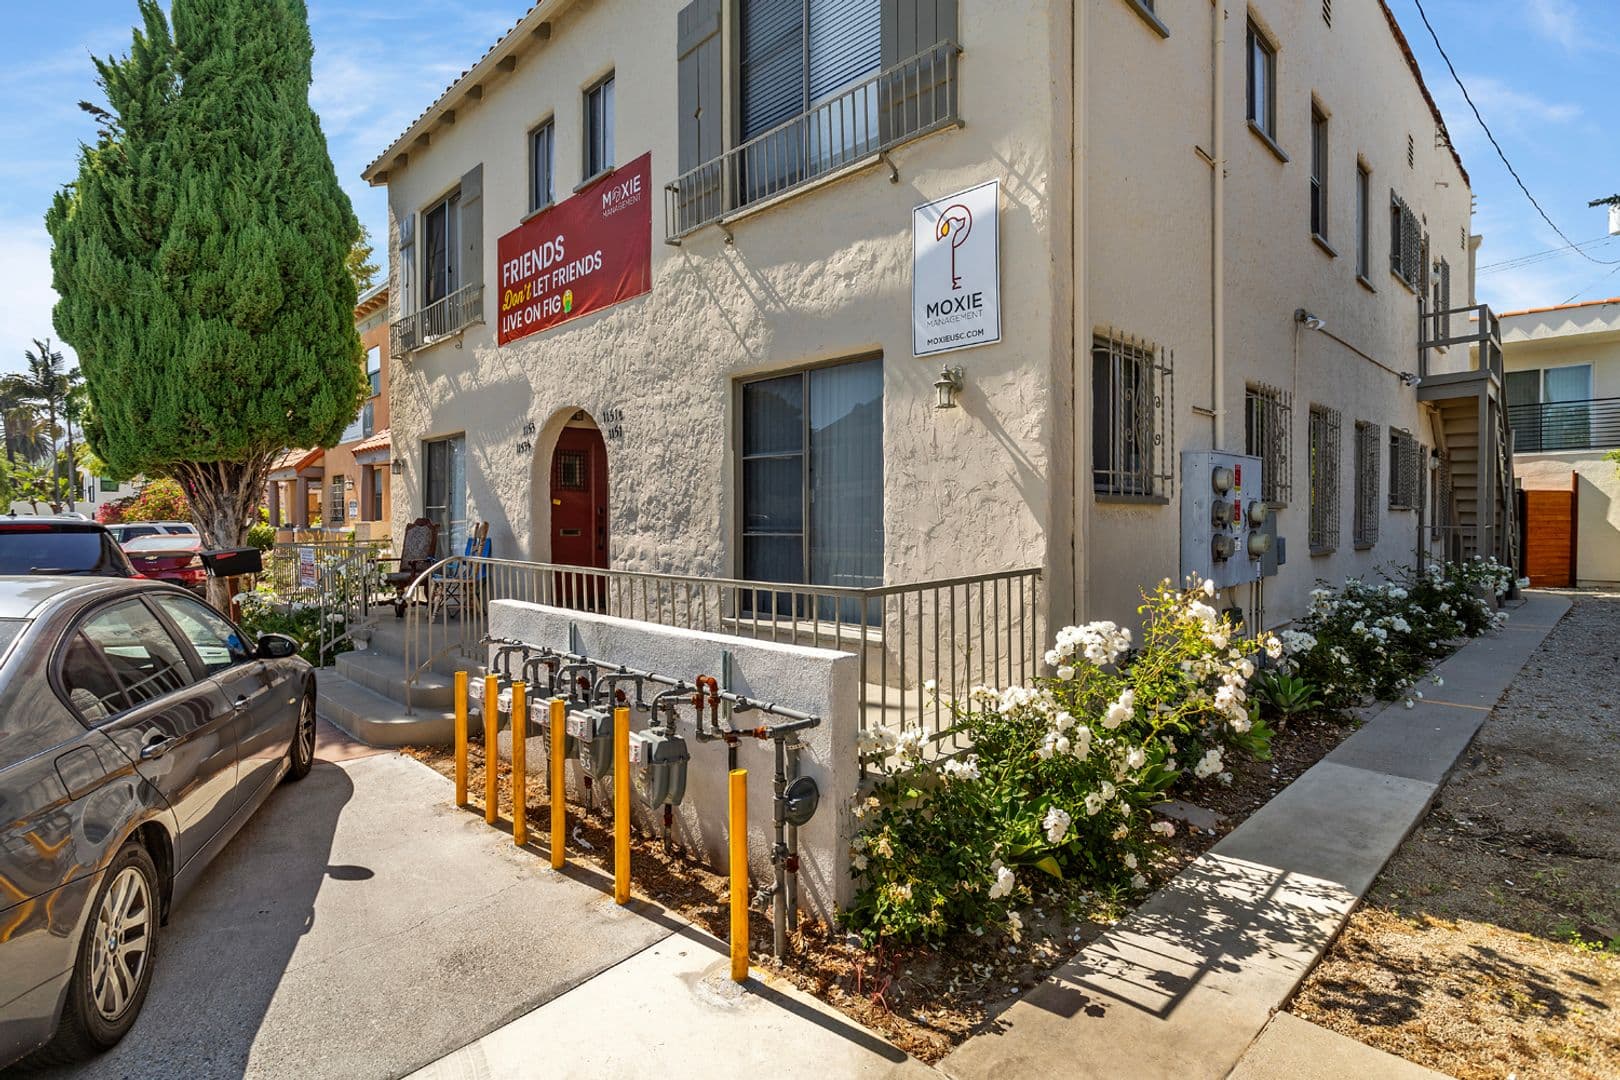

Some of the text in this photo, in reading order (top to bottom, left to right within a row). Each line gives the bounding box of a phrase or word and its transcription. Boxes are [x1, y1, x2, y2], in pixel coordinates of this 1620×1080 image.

[602, 192, 641, 218] MANAGEMENT
[503, 235, 564, 288] FRIENDS
[502, 250, 602, 311] Don't LET FRIENDS
[503, 294, 561, 333] LIVE ON FIG
[926, 291, 983, 319] MOXIE
[926, 309, 983, 328] MANAGEMENT
[926, 328, 984, 346] MOXIEUSC.COM
[608, 425, 623, 440] 1151
